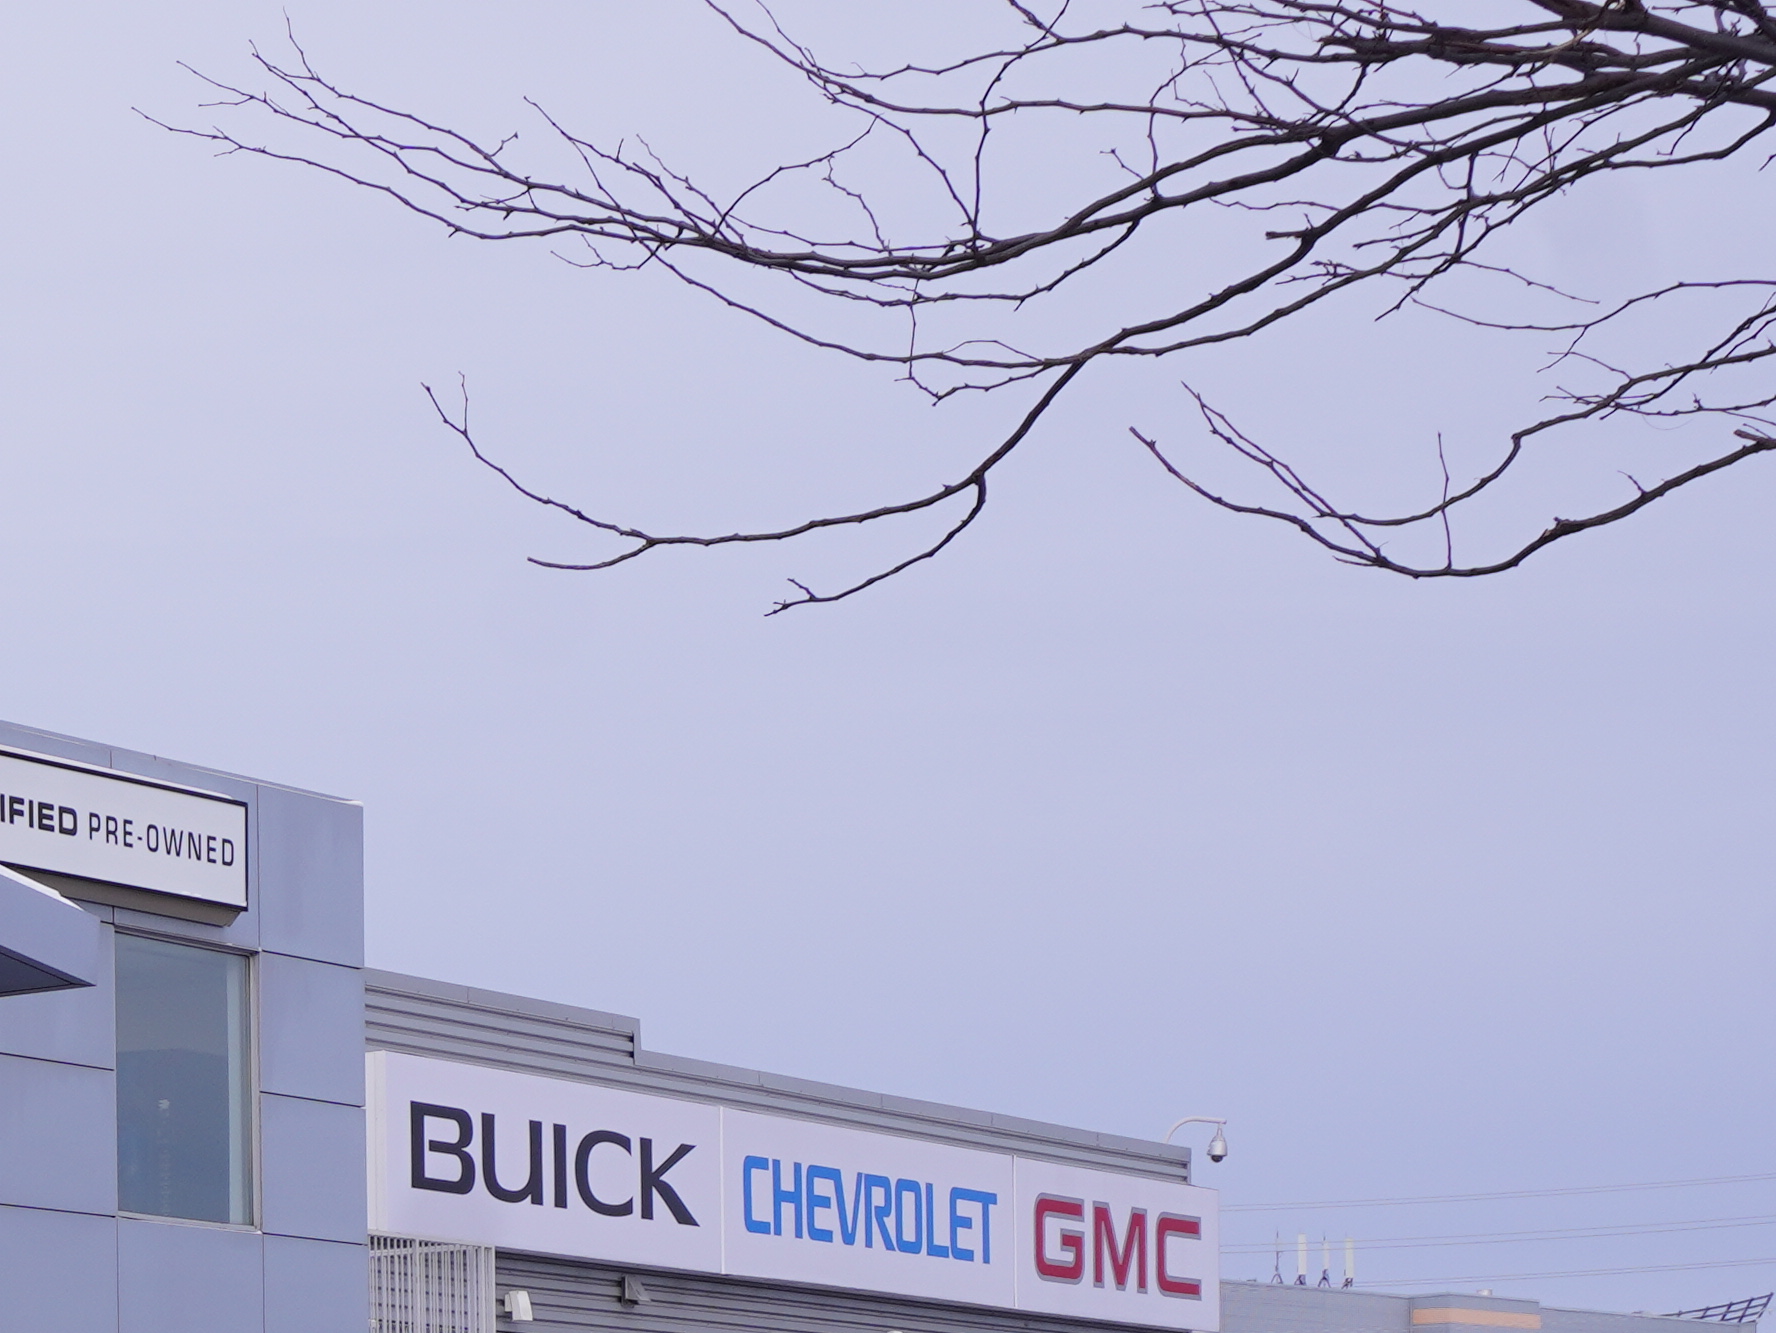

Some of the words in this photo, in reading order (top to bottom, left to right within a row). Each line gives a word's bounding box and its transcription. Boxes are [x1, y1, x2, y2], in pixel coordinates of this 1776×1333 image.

[89, 812, 235, 867] PRE-OWNED
[410, 1101, 700, 1228] BUICK
[741, 1155, 998, 1265] CHEVROLET
[1033, 1192, 1203, 1301] GMC
